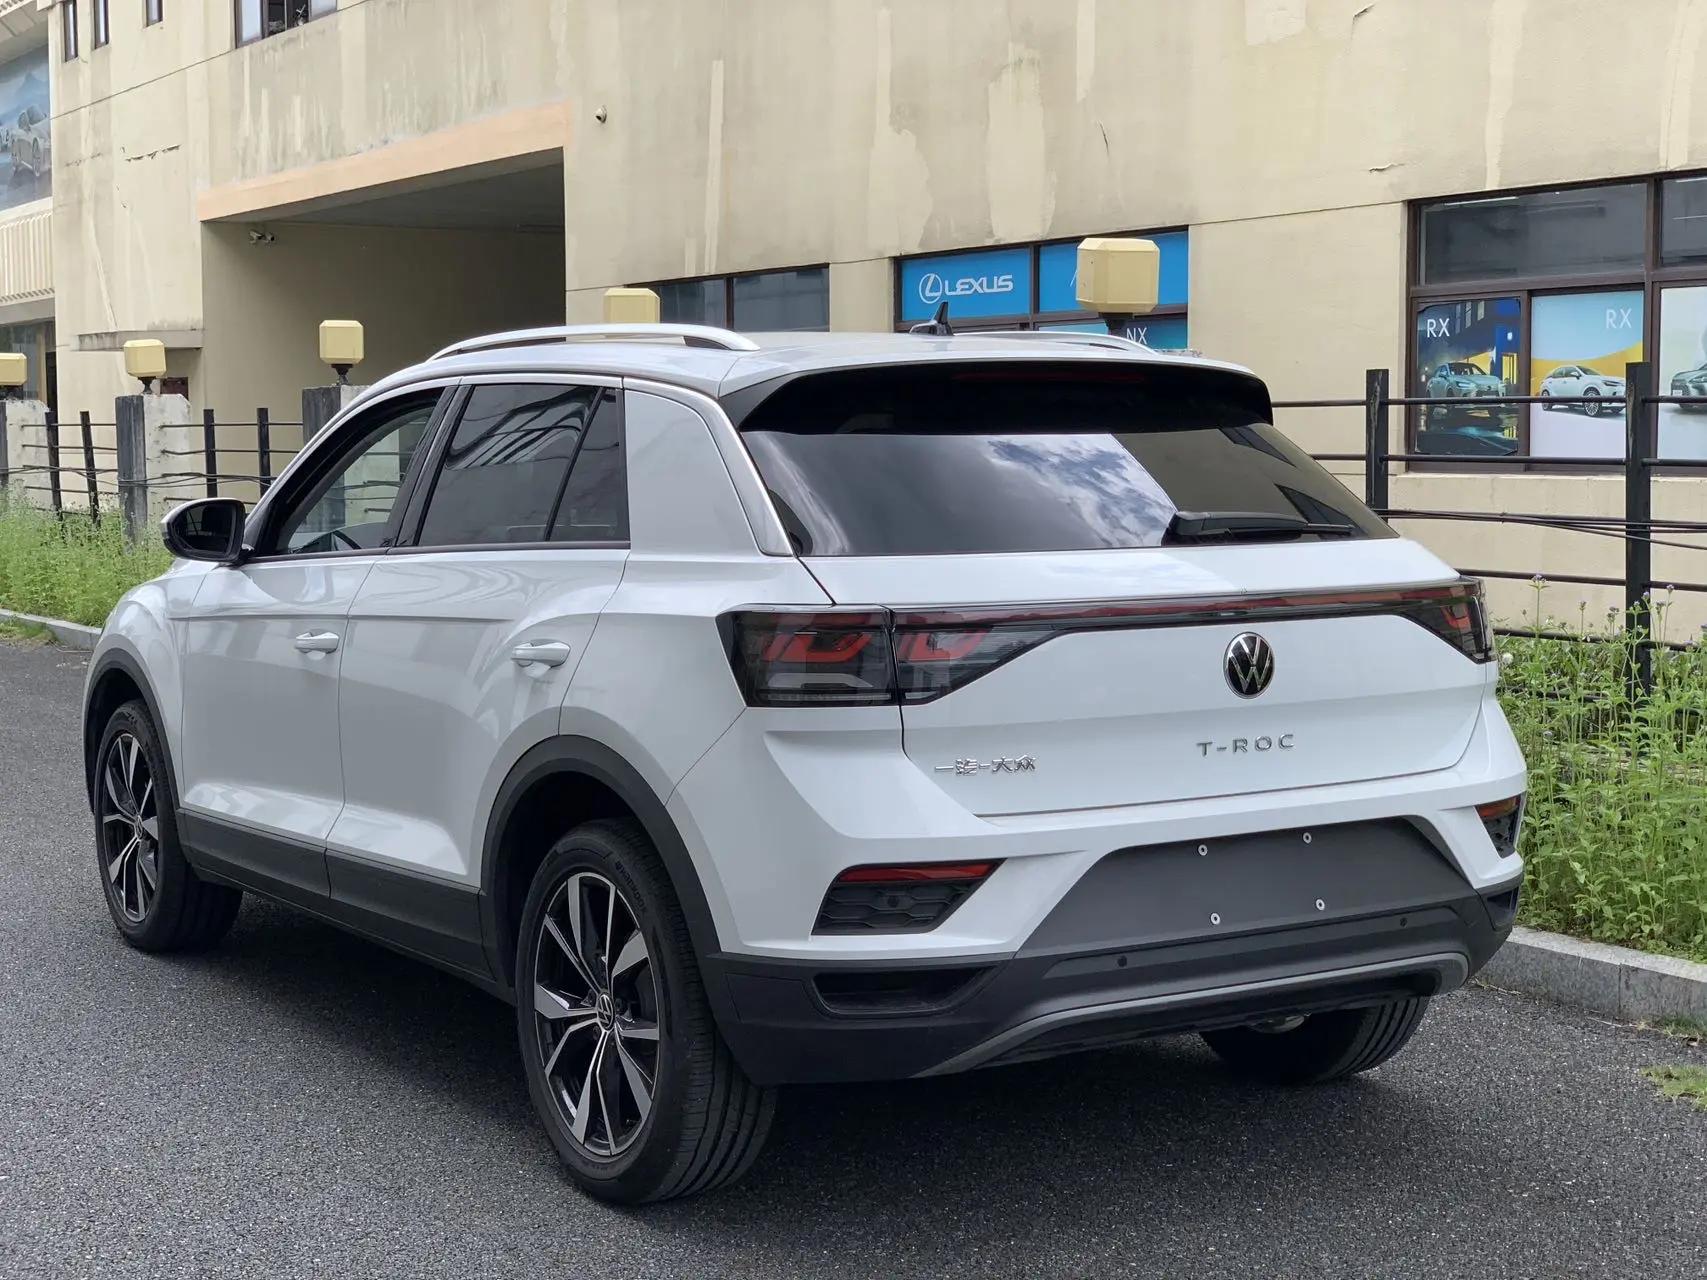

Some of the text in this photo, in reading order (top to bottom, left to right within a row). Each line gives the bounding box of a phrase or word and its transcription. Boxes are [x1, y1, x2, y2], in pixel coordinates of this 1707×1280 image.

[945, 274, 1014, 296] LEXUS
[1426, 317, 1451, 338] RX
[1606, 308, 1632, 330] RX
[1126, 327, 1148, 345] NX
[1196, 733, 1295, 757] T-ROC
